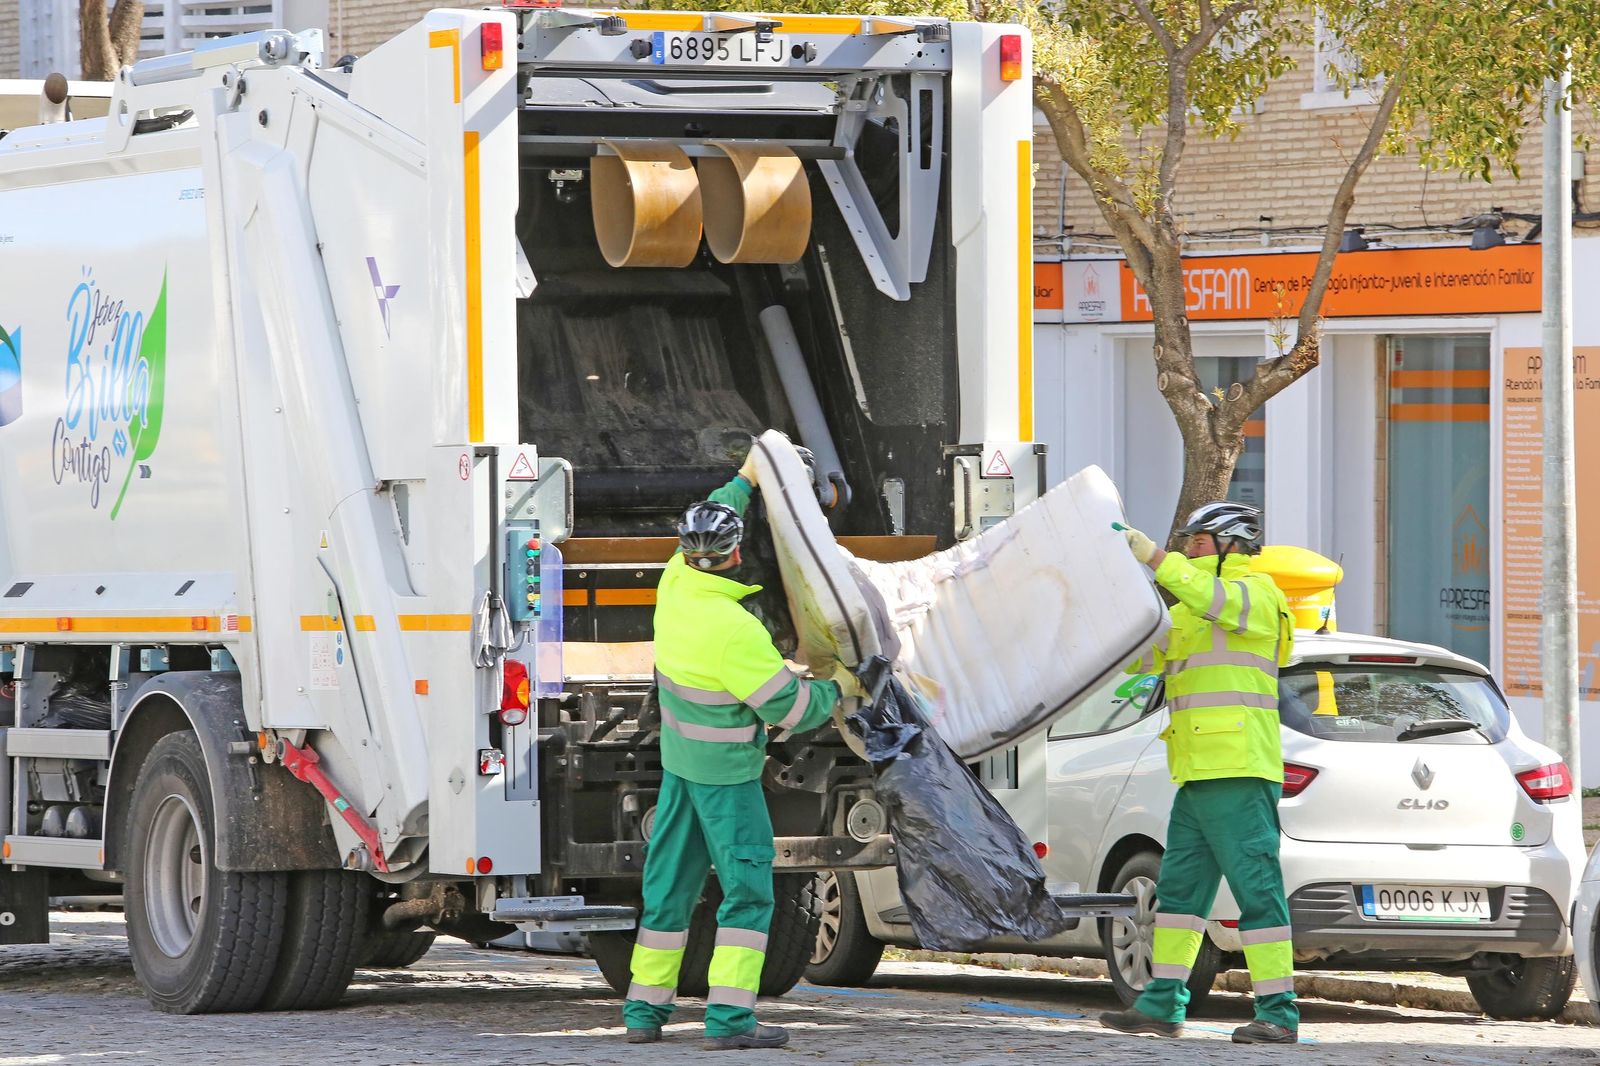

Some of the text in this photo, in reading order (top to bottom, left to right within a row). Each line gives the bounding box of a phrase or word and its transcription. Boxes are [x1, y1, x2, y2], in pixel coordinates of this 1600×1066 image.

[670, 36, 729, 61] 6895
[740, 37, 783, 62] LFJ
[1287, 276, 1299, 292] de
[1302, 273, 1348, 295] Psogía
[1425, 277, 1431, 288] e
[1434, 269, 1496, 288] Intervención
[1499, 268, 1535, 285] Familiar
[65, 282, 149, 442] Brilla
[52, 416, 111, 509] Contigo
[1440, 588, 1490, 610] APRESFA
[1397, 798, 1450, 811] CLIO
[1379, 889, 1434, 912] 0006
[1441, 890, 1483, 914] KJX
